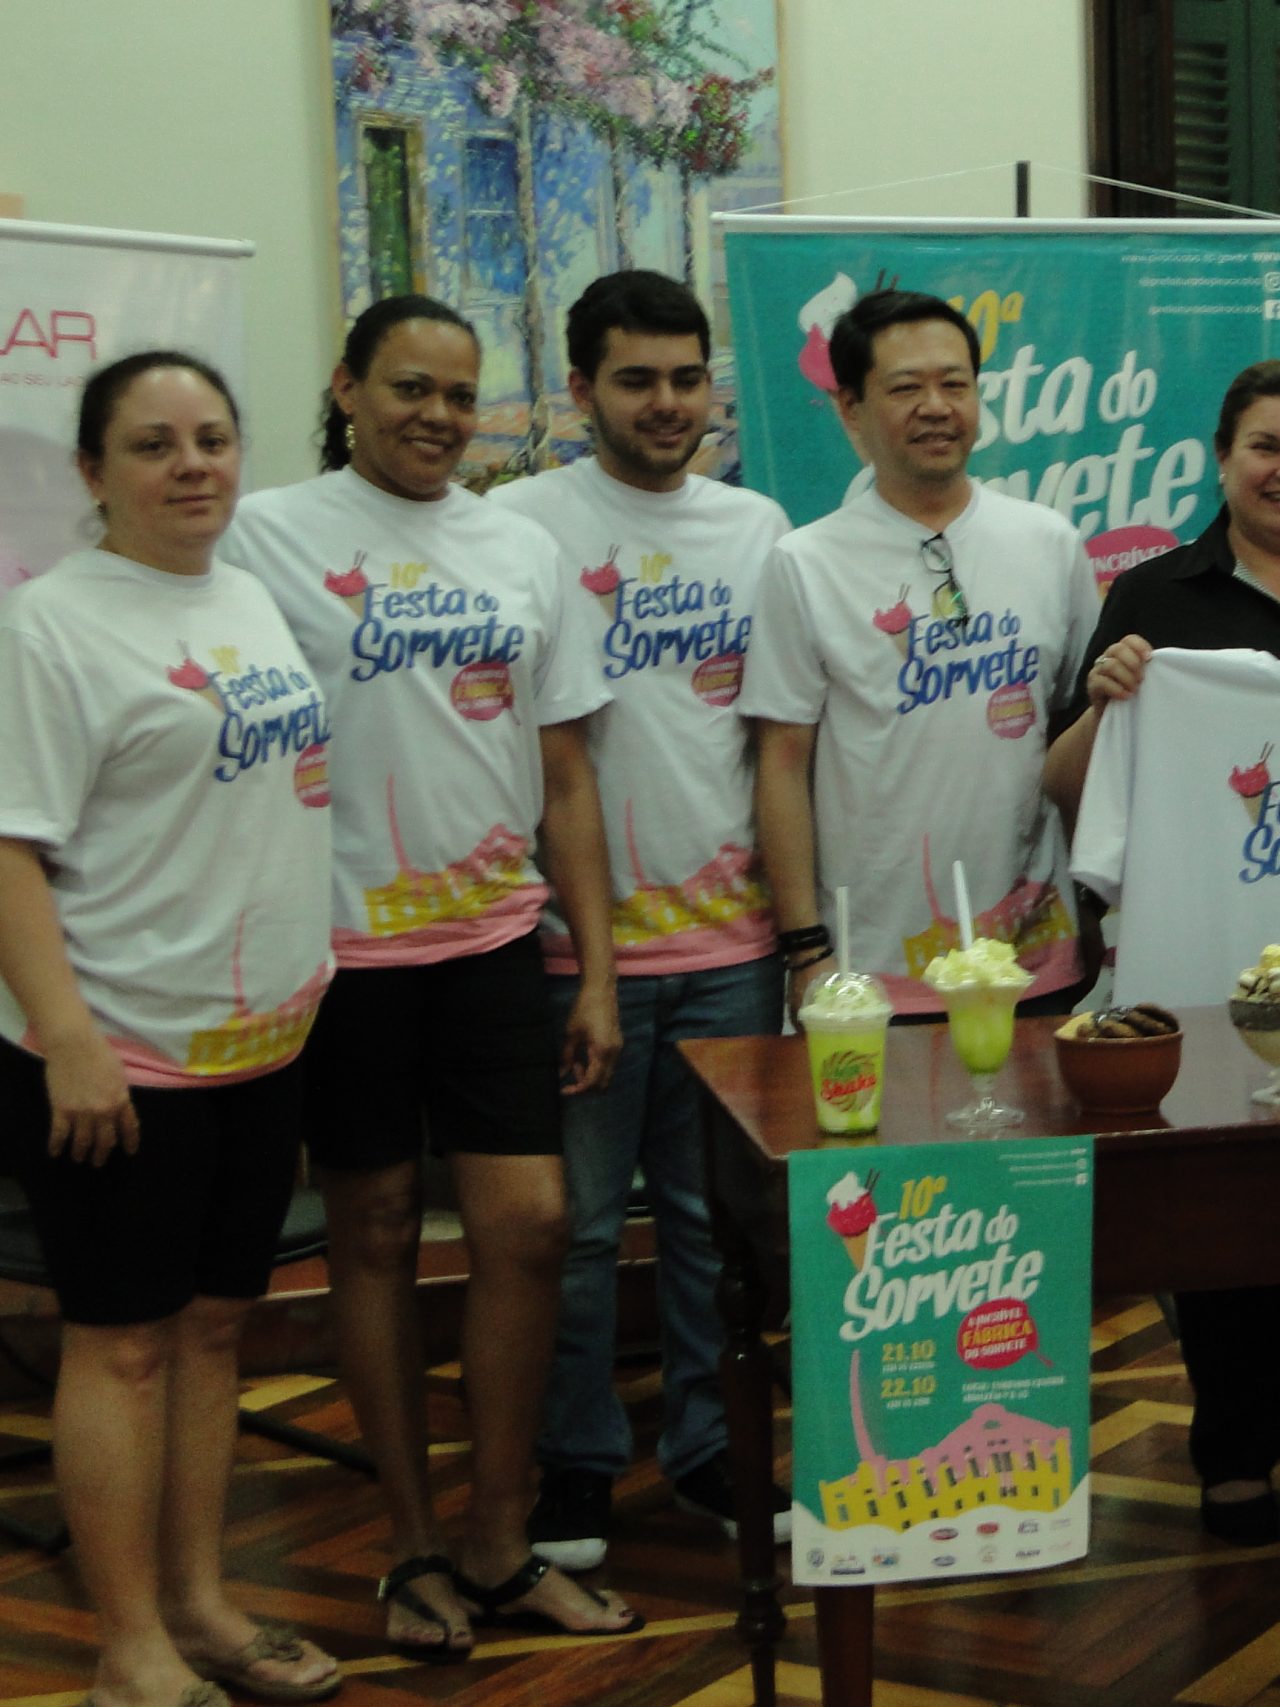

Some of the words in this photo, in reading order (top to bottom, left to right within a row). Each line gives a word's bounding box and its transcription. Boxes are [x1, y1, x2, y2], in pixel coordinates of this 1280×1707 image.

[1099, 349, 1157, 424] do
[364, 582, 468, 622] Festa
[614, 575, 704, 622] Festa
[710, 577, 732, 607] do
[999, 608, 1021, 638] do
[351, 615, 525, 682] Sorvete
[603, 608, 752, 679] Sorvete
[897, 638, 1040, 715] Sorvete
[861, 1203, 983, 1272] Festa
[985, 1203, 1019, 1244] do
[839, 1244, 1045, 1342] Sorvete
[882, 1339, 937, 1362] 21.10
[880, 1374, 938, 1398] 22.10
